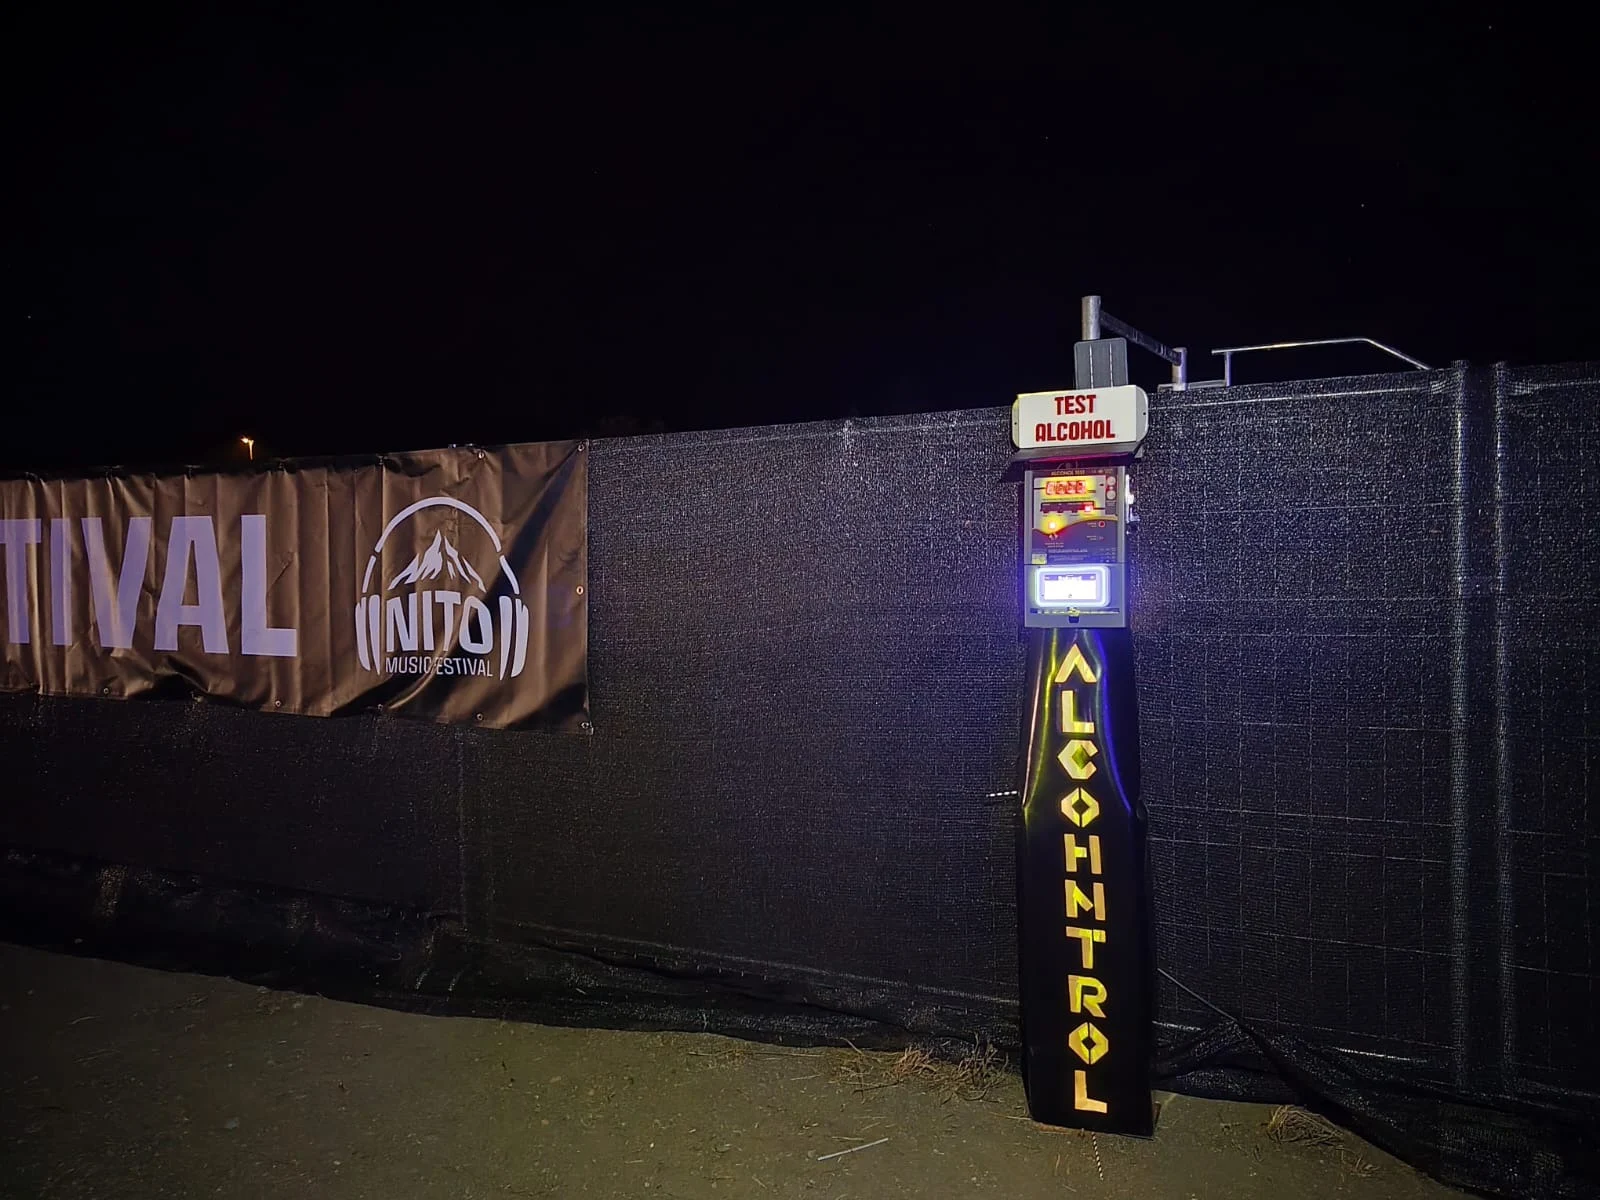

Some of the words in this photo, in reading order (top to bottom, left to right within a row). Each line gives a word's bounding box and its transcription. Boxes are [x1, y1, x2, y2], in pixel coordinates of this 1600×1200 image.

[1054, 394, 1097, 415] TEST
[1035, 419, 1116, 442] ALCOHOL
[386, 590, 494, 655] NITO
